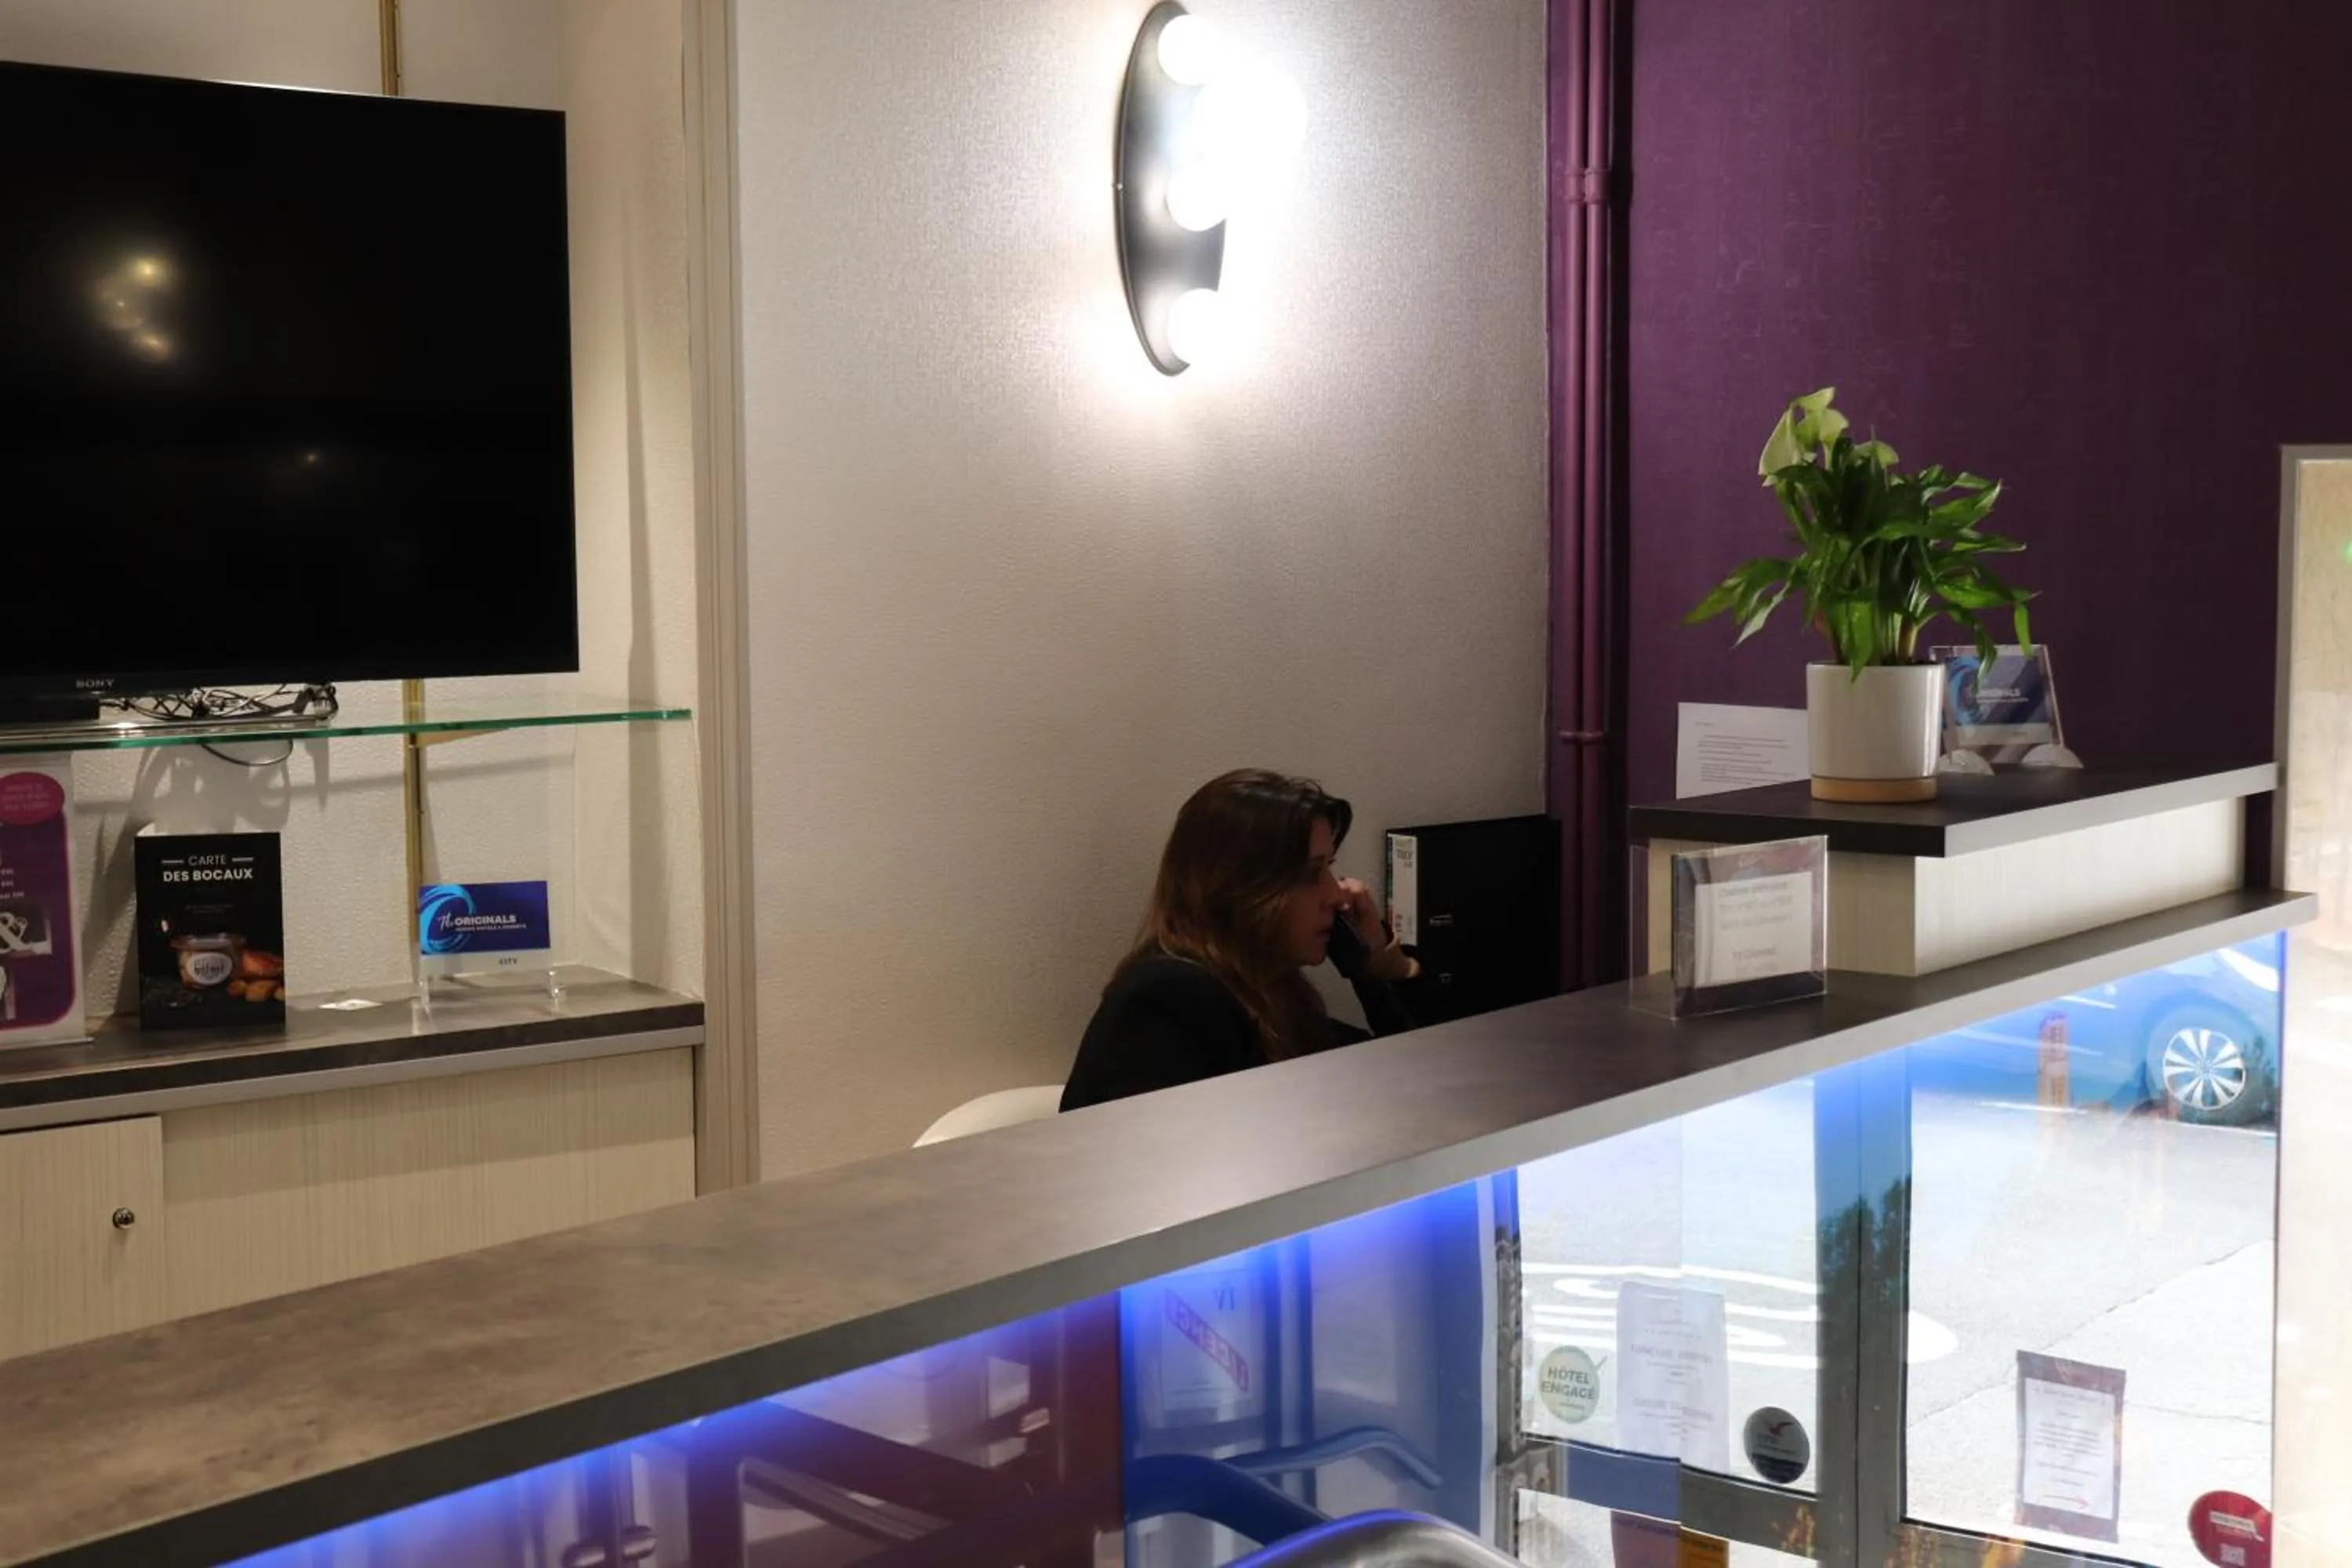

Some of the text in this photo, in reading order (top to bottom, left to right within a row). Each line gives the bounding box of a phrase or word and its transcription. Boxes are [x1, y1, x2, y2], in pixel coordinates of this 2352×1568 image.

[76, 678, 114, 689] SONY
[187, 855, 227, 866] CARTE
[163, 869, 252, 882] DES BOCAUX
[454, 915, 517, 927] ORIGINALS
